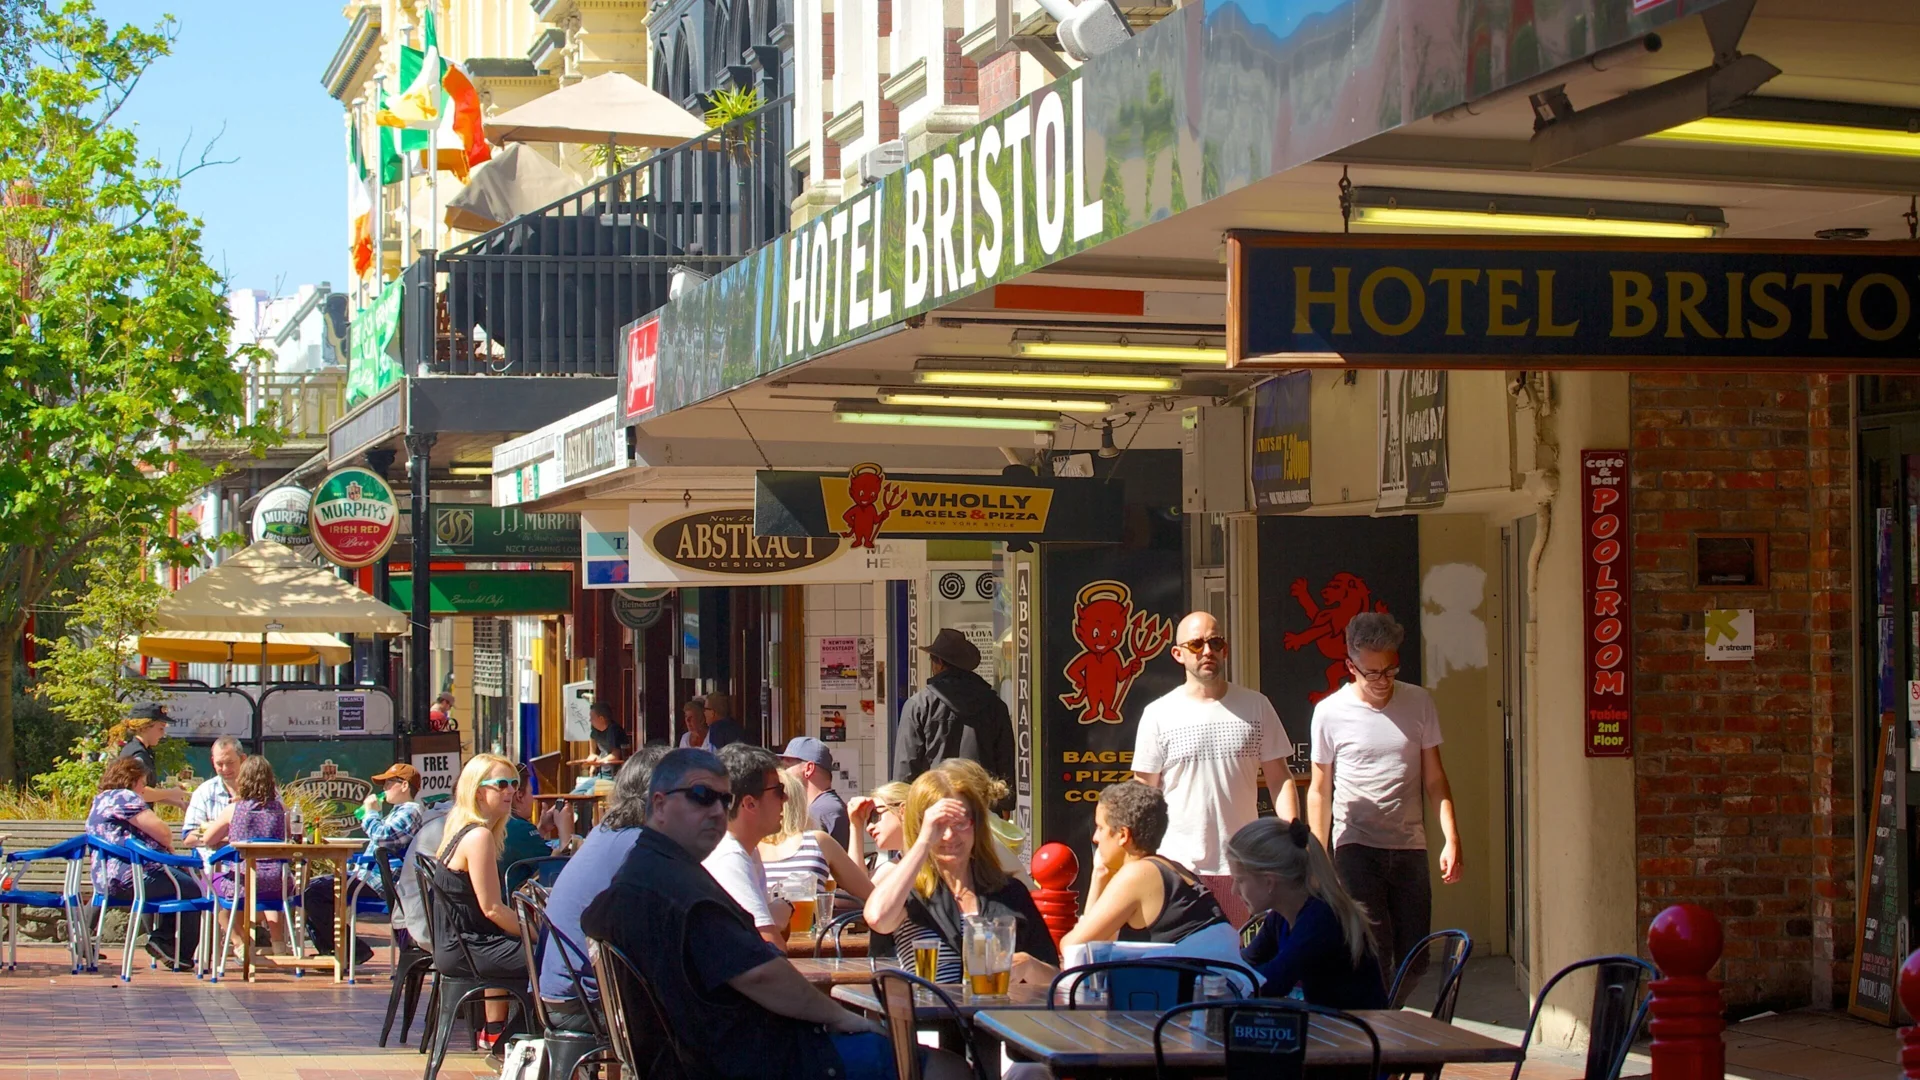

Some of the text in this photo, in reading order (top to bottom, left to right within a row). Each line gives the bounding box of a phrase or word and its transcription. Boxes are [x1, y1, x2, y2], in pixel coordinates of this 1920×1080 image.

[786, 77, 1103, 355] HOTEL BRISTOL
[1292, 265, 1910, 341] HOTEL BRISTO
[1405, 406, 1445, 443] MONDAY
[1586, 458, 1624, 469] cafe
[1599, 468, 1612, 478] &
[1590, 475, 1620, 486] bar
[911, 492, 1032, 509] WHOLLY
[321, 502, 388, 522] MURPHY'S
[901, 509, 1039, 521] BAGELS & PIZZA
[493, 509, 523, 535] J.J.
[330, 525, 380, 533] IRISH RED
[265, 531, 287, 544] IRISH
[676, 523, 815, 559] ABSTRACT
[505, 545, 525, 553] NZCT
[528, 545, 561, 553] GAMING
[1591, 488, 1624, 696] POOLROOM
[621, 600, 657, 608] Heineken
[1590, 708, 1627, 721] Tables
[1598, 722, 1619, 733] 2nd
[1593, 734, 1624, 747] Floor
[423, 755, 449, 772] FREE
[1063, 751, 1134, 763] BAGE
[421, 775, 453, 790] POOL
[1076, 770, 1134, 782] PIZZ
[1064, 790, 1100, 802] CO
[1235, 1026, 1295, 1041] BRISTOL
